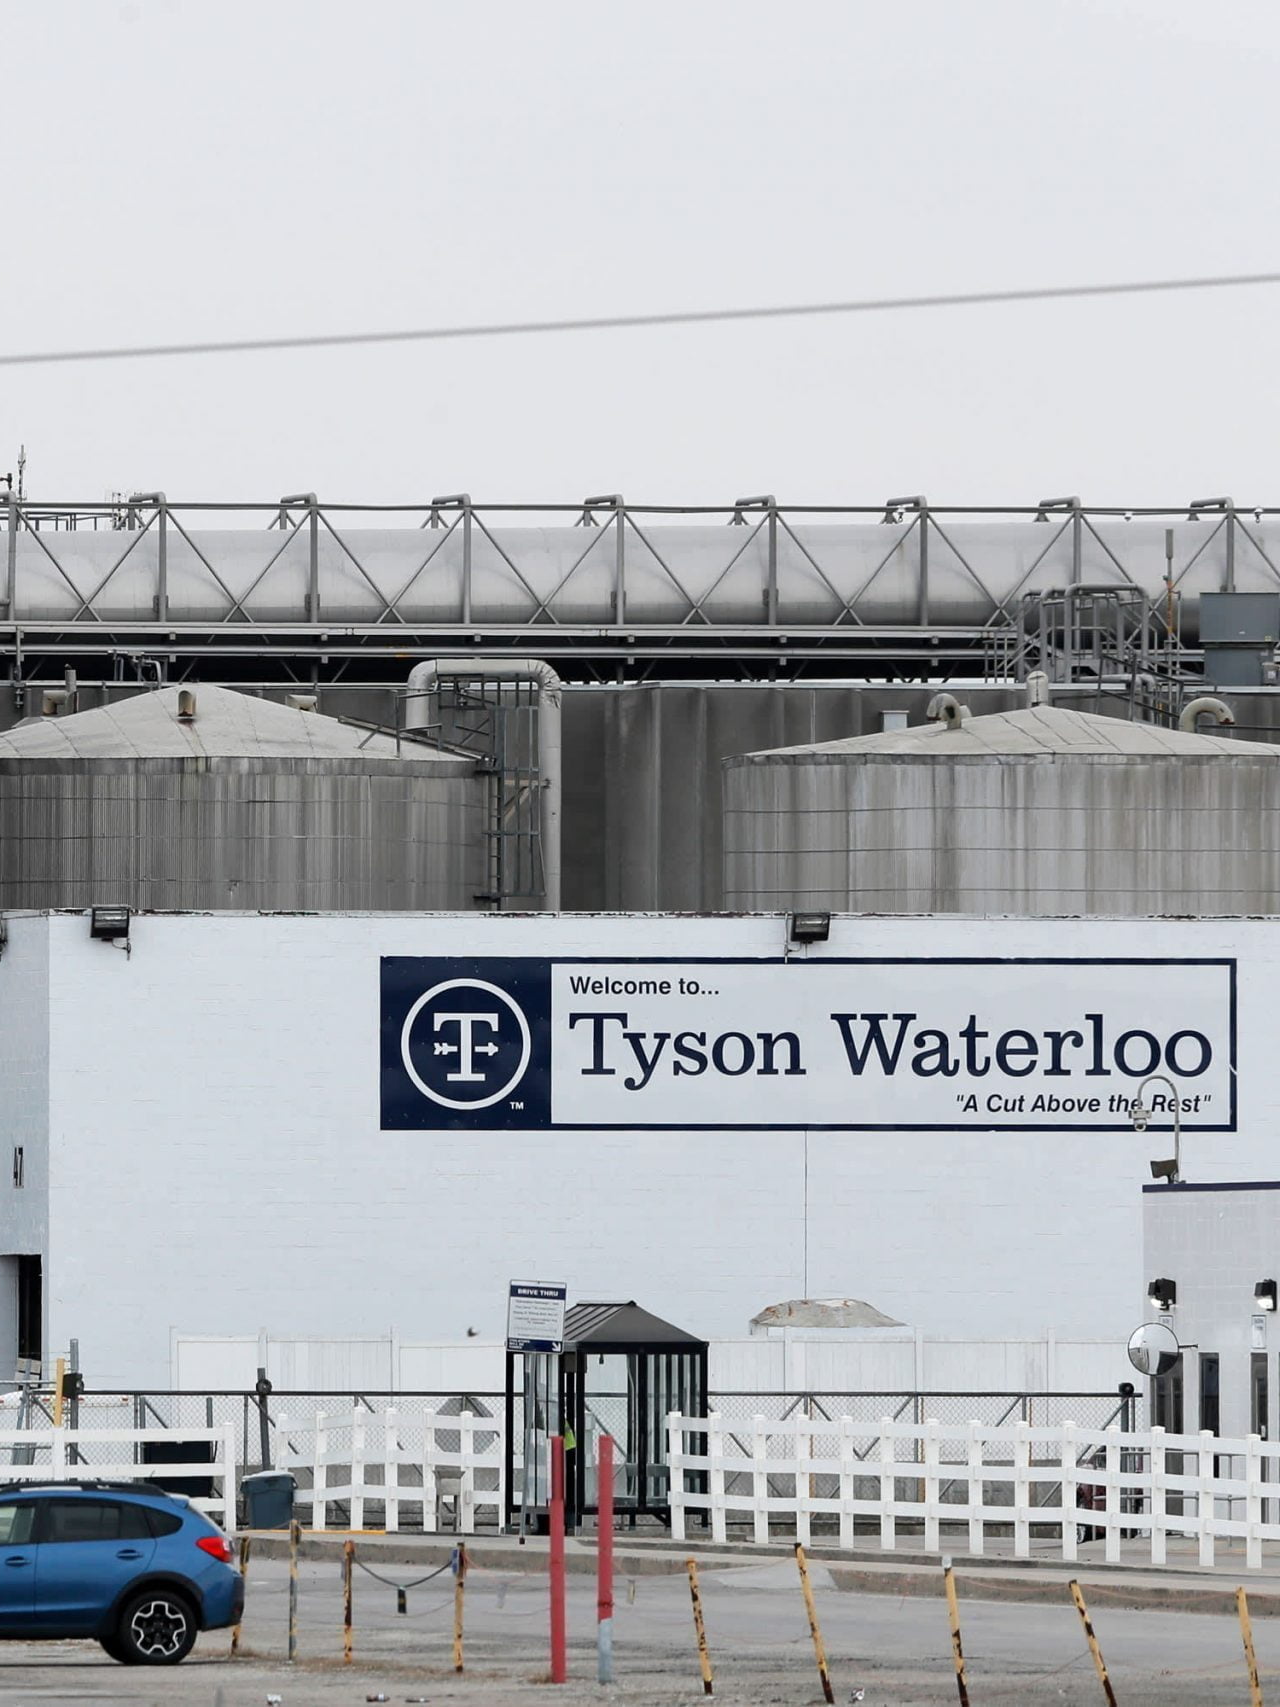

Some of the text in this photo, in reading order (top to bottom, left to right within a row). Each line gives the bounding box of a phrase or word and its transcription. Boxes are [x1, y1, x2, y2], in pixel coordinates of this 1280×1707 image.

[570, 976, 719, 995] Welcome to...
[569, 1012, 1213, 1091] Tyson Waterloo
[956, 1094, 978, 1113] "A
[986, 1094, 1025, 1113] Cut
[1031, 1094, 1101, 1113] Above
[1108, 1094, 1144, 1113] the
[517, 1288, 538, 1296] DRIVE
